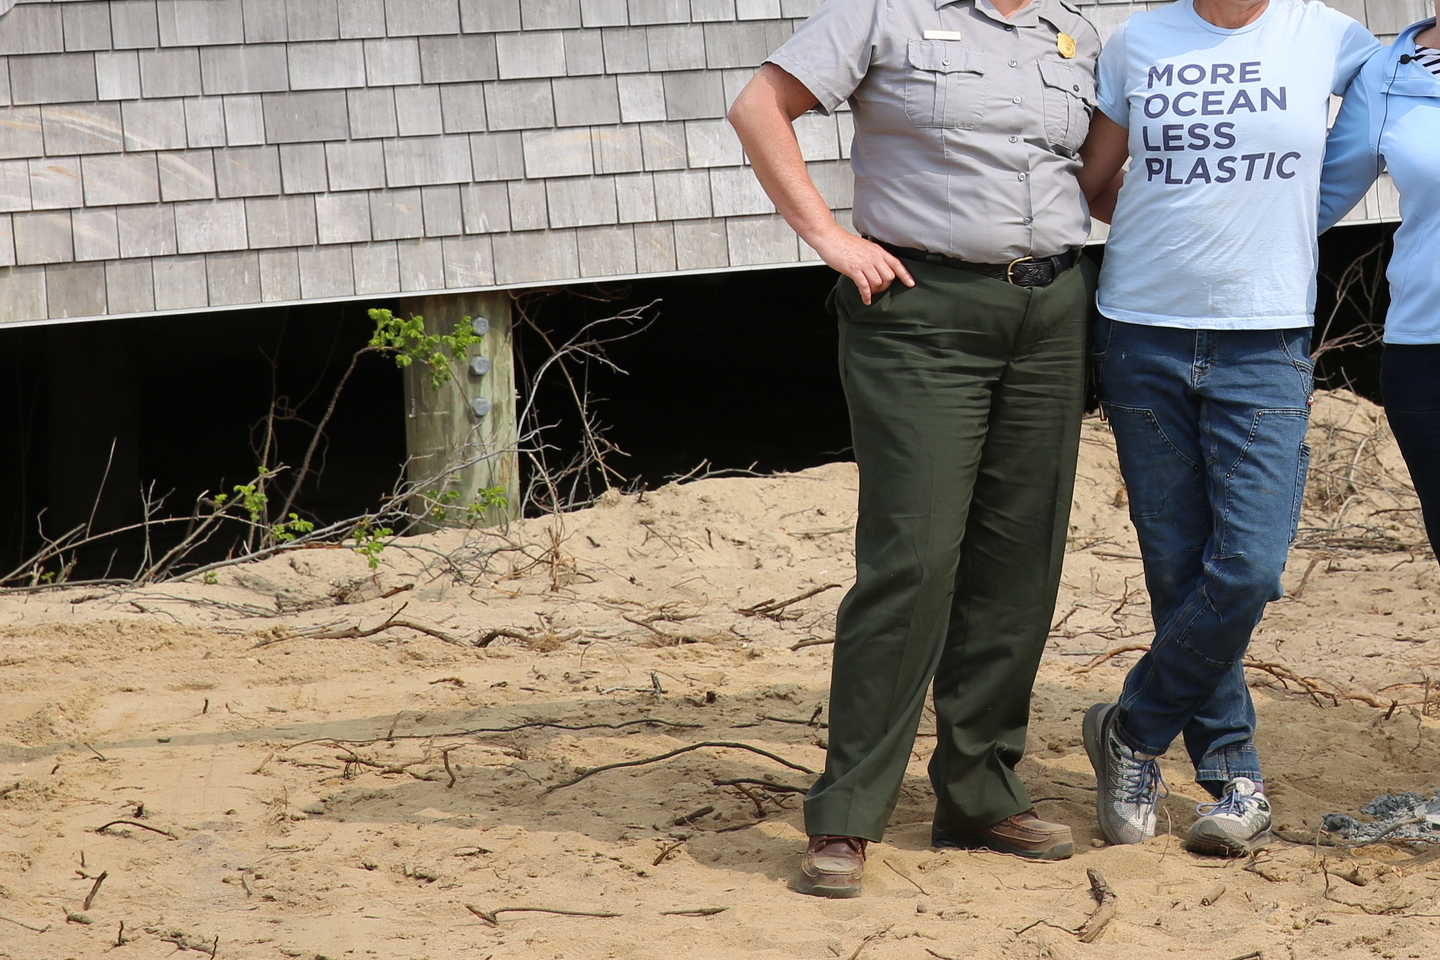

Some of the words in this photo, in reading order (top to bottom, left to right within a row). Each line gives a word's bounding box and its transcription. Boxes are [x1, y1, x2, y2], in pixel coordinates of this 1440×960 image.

[1147, 61, 1262, 90] MORE
[1143, 86, 1287, 119] OCEAN
[1142, 122, 1236, 152] LESS
[1145, 151, 1302, 185] PLASTIC
